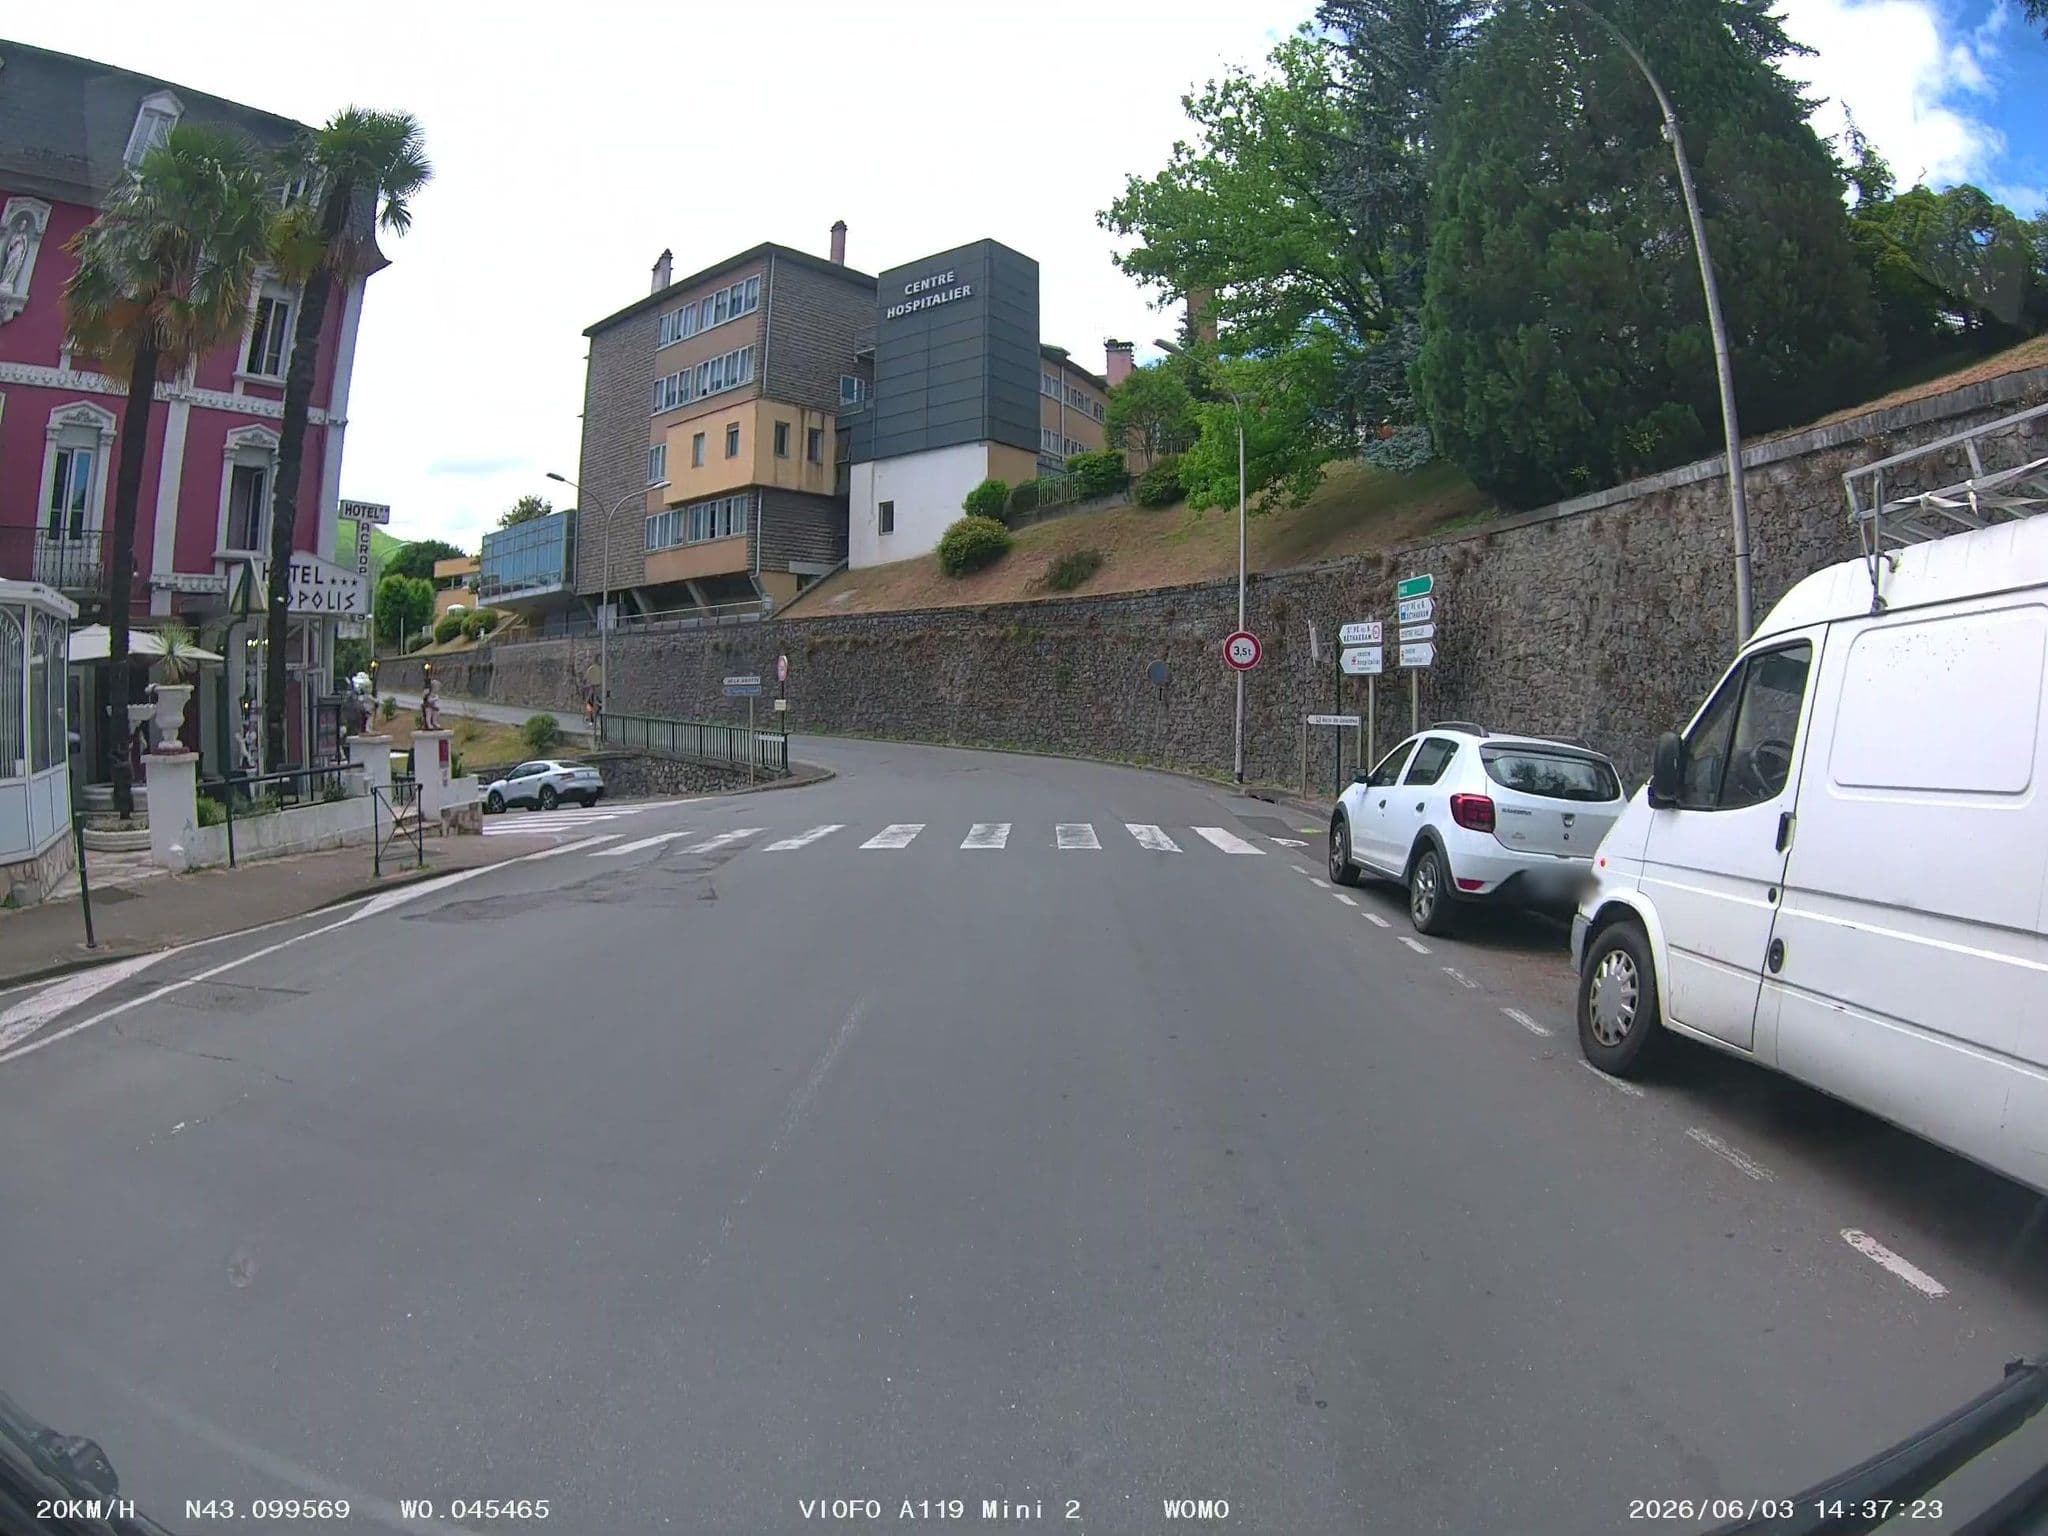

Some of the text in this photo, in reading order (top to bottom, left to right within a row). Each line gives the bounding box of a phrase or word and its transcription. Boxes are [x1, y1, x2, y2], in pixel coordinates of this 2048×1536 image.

[904, 271, 954, 295] CENTRE
[887, 285, 971, 319] HOSPITALIER
[345, 503, 379, 518] HOTEL
[359, 522, 370, 574] ACROP
[262, 562, 324, 585] HTEL
[1233, 645, 1252, 657] 3,5t
